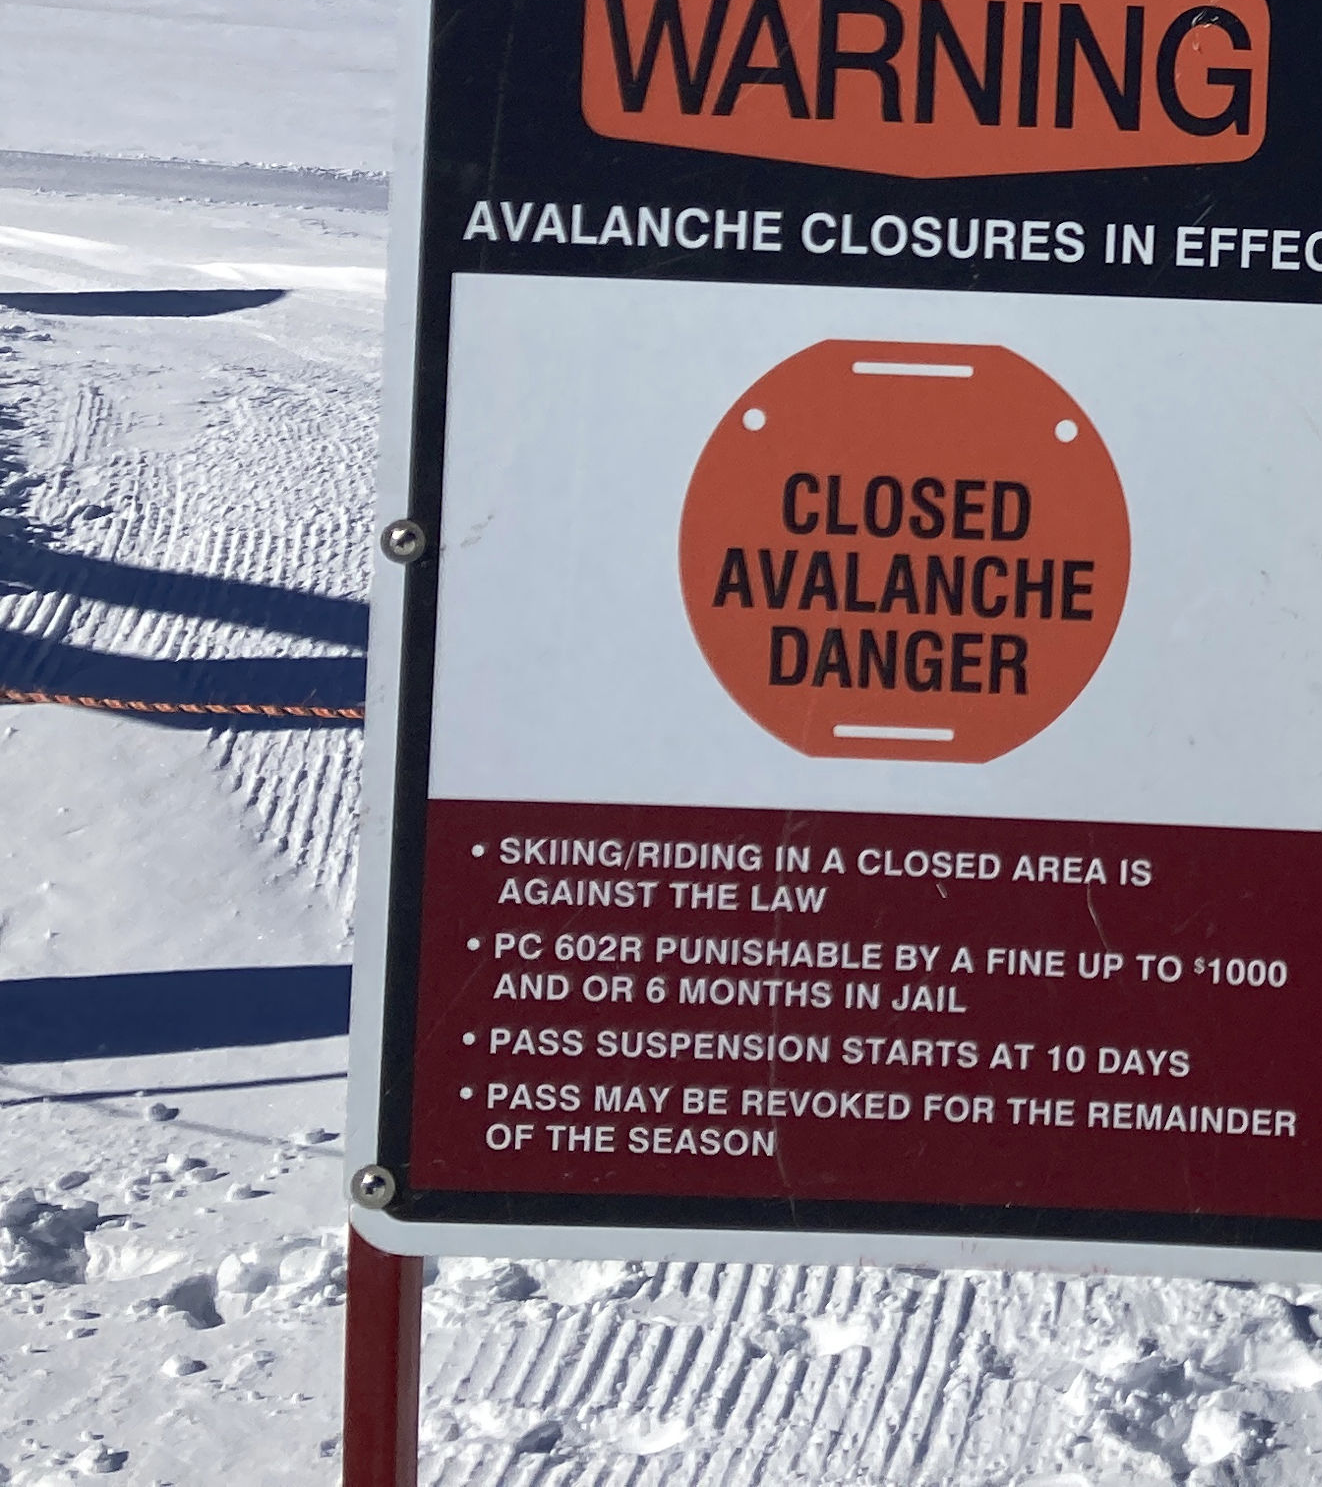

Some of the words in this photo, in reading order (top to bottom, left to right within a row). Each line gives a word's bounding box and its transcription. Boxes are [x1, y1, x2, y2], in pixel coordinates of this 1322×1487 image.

[463, 201, 782, 251] AVALANCHE
[802, 213, 1084, 262] CLOSURES
[1106, 224, 1154, 264] IN
[783, 473, 1031, 541] CLOSED
[714, 548, 1094, 621] AVALANCHE
[770, 626, 1027, 694] DANGER
[500, 838, 762, 870] SKIING/RIDING
[776, 846, 810, 872] IN
[822, 848, 844, 873] A
[858, 849, 1000, 879] CLOSED
[1013, 855, 1106, 884] AREA
[1120, 859, 1151, 886] IS
[498, 878, 659, 907] AGAINST
[669, 883, 738, 910] THE
[752, 885, 827, 912] LAW
[495, 933, 543, 959] PC
[555, 934, 641, 961] 602R
[657, 937, 881, 969] PUNISHABLE
[896, 945, 940, 971] BY
[951, 947, 973, 973] A
[988, 948, 1064, 977] FINE
[1079, 953, 1123, 979] UP
[1136, 955, 1182, 982] TO
[1194, 957, 1287, 987] $1000
[494, 974, 569, 1000] AND
[583, 975, 633, 1002] OR
[647, 977, 665, 1003] 6
[680, 978, 832, 1008] MONTHS
[846, 983, 879, 1009] IN
[892, 985, 966, 1012] JAIL
[490, 1028, 583, 1056] PASS
[597, 1030, 829, 1062] SUSPENSION
[843, 1037, 978, 1068] STARTS
[990, 1043, 1034, 1069] AT
[1048, 1046, 1085, 1072] 10
[1099, 1047, 1189, 1077] DAYS
[488, 1083, 580, 1111] PASS
[595, 1086, 670, 1112] MAY
[683, 1088, 727, 1114] BE
[742, 1090, 910, 1119] REVOKED
[924, 1095, 993, 1123] FOR
[1007, 1098, 1074, 1126] THE
[1089, 1102, 1296, 1136] REMAINDER
[486, 1124, 534, 1150] OF
[546, 1126, 614, 1152] THE
[629, 1127, 776, 1156] SEASON
